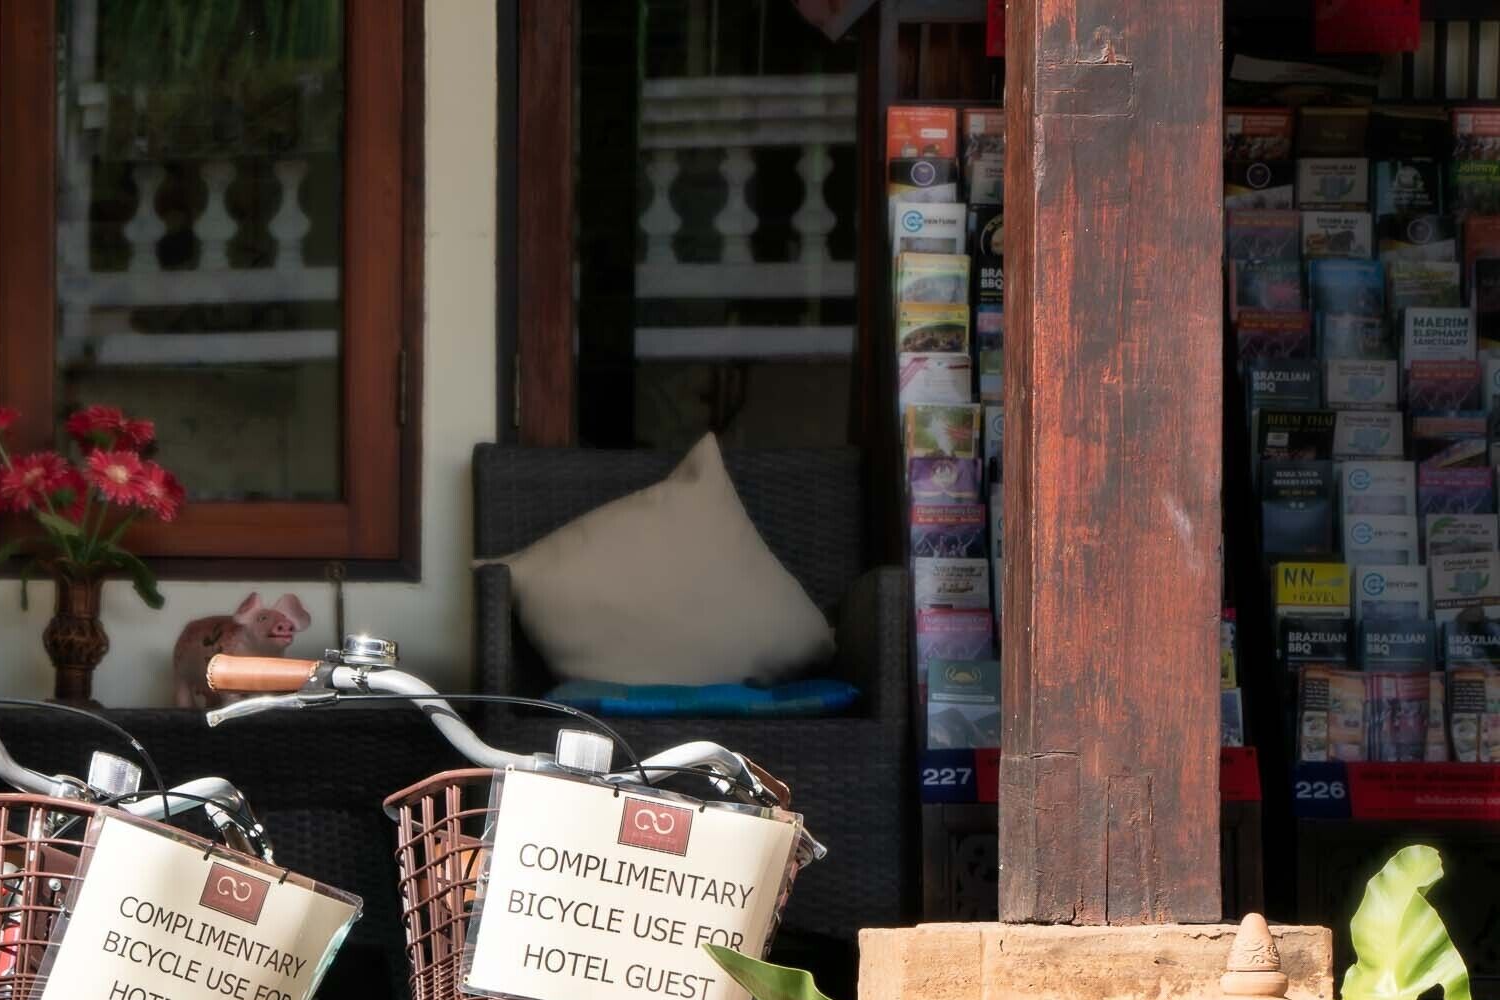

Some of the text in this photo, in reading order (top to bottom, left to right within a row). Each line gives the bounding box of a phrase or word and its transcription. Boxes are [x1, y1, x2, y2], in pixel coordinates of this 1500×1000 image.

[980, 268, 1004, 278] BRA
[1413, 316, 1469, 328] MAERIM
[1413, 328, 1469, 337] ELEPHANT
[1413, 337, 1469, 346] SANCTUARY
[1252, 370, 1311, 382] BRAZILIAN
[1252, 382, 1277, 392] BBQ
[1293, 591, 1337, 602] TRAVEL
[1287, 631, 1347, 643] BRAZILIAN
[1366, 632, 1427, 644] BRAZILIAN
[1448, 634, 1500, 646] BRAZILIA
[1287, 643, 1312, 654] BBQ
[1366, 643, 1390, 655] BBQ
[1448, 645, 1473, 656] BBQ
[923, 767, 972, 786] 227
[1295, 781, 1346, 799] 226
[519, 843, 755, 910] COMPLIMENTARY
[508, 889, 745, 953] BICYCLE USE FOR
[119, 896, 308, 980] COMPLIMENTARY
[102, 931, 202, 984] BICYCLE
[206, 966, 252, 1000] USE
[523, 943, 614, 985] HOTEL
